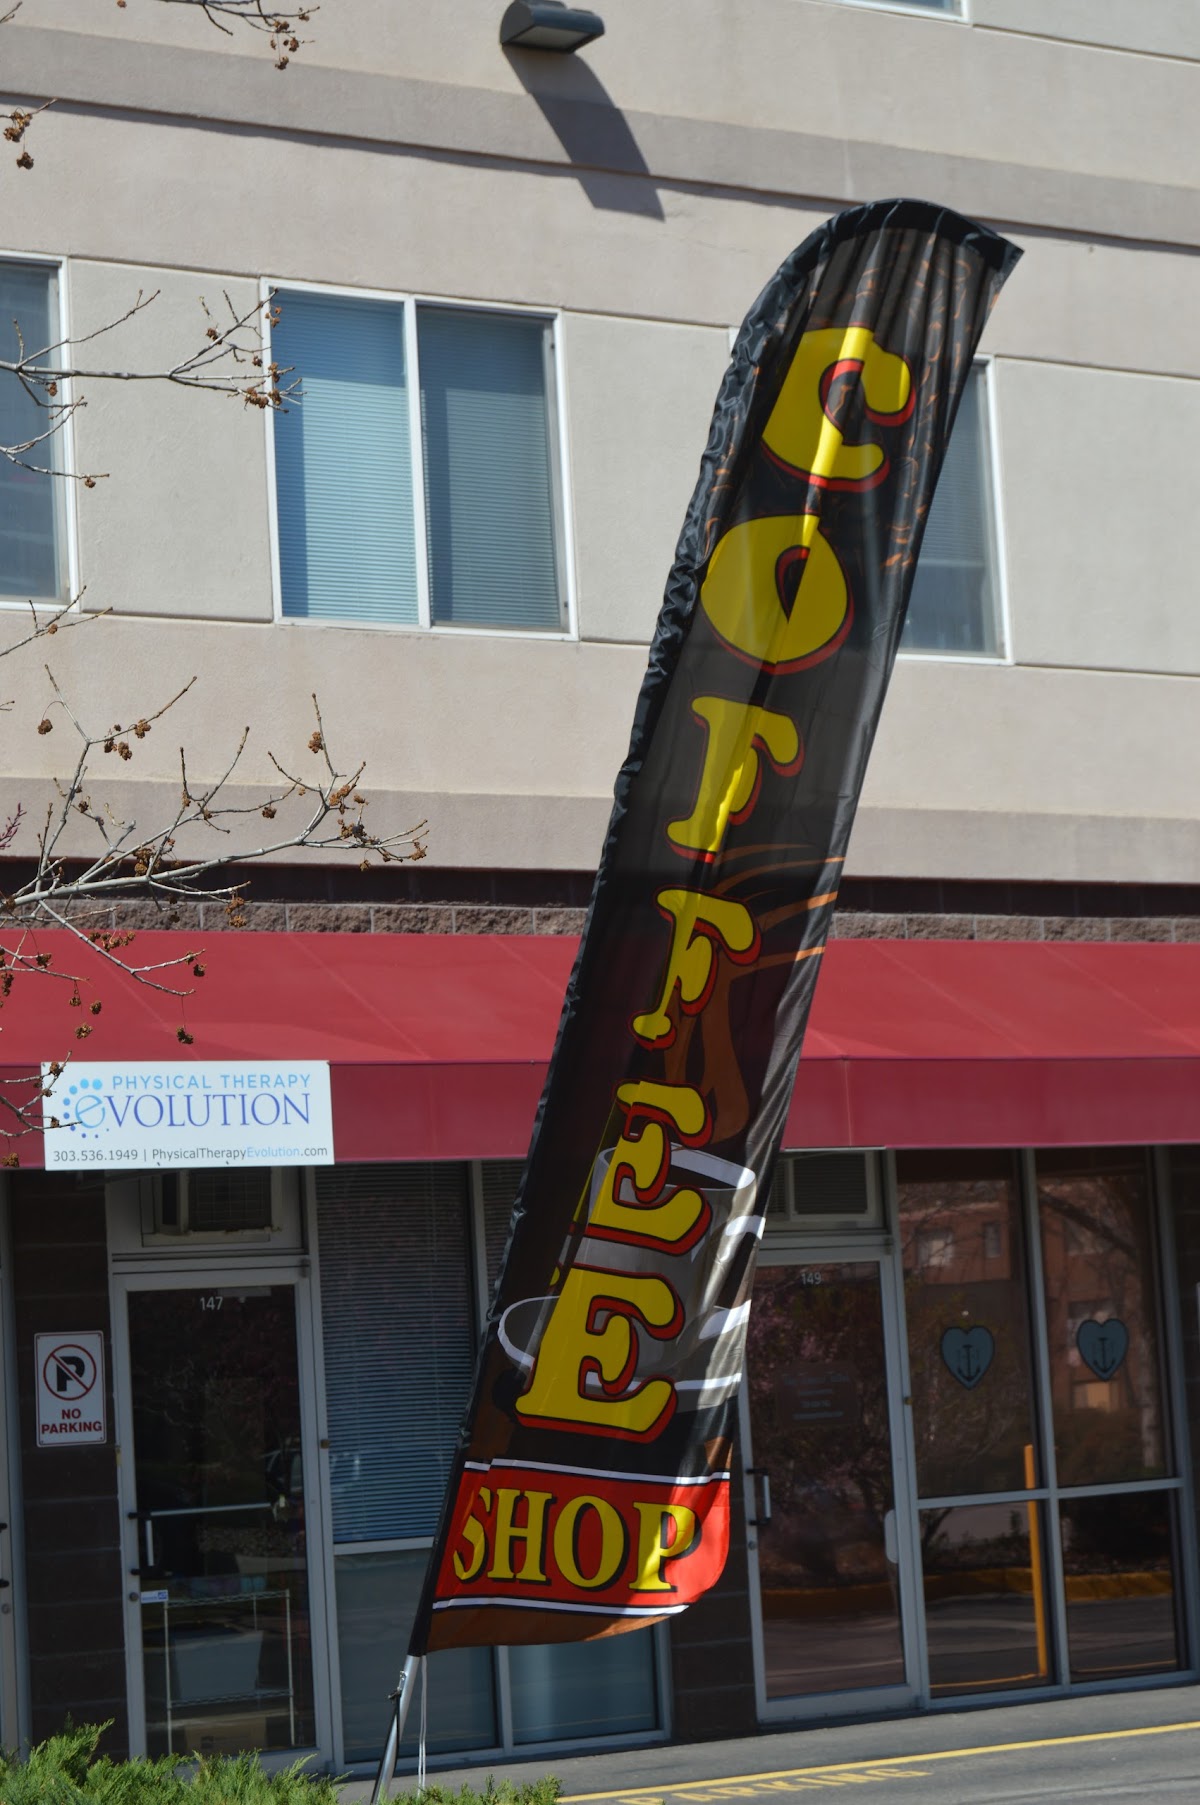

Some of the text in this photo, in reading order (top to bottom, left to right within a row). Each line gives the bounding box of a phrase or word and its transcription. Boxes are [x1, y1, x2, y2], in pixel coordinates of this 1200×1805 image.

[515, 324, 917, 1444] COFFEE
[112, 1073, 311, 1090] PHYSICAL THERAPY
[53, 1146, 328, 1162] 303.536.1949 PhysicalTherapyEvolution.com
[800, 1271, 823, 1286] 149
[200, 1295, 224, 1311] 147
[61, 1407, 82, 1421] NO
[41, 1420, 103, 1435] PARKING
[452, 1486, 700, 1593] SHOP
[616, 1767, 934, 1805] PARKING
